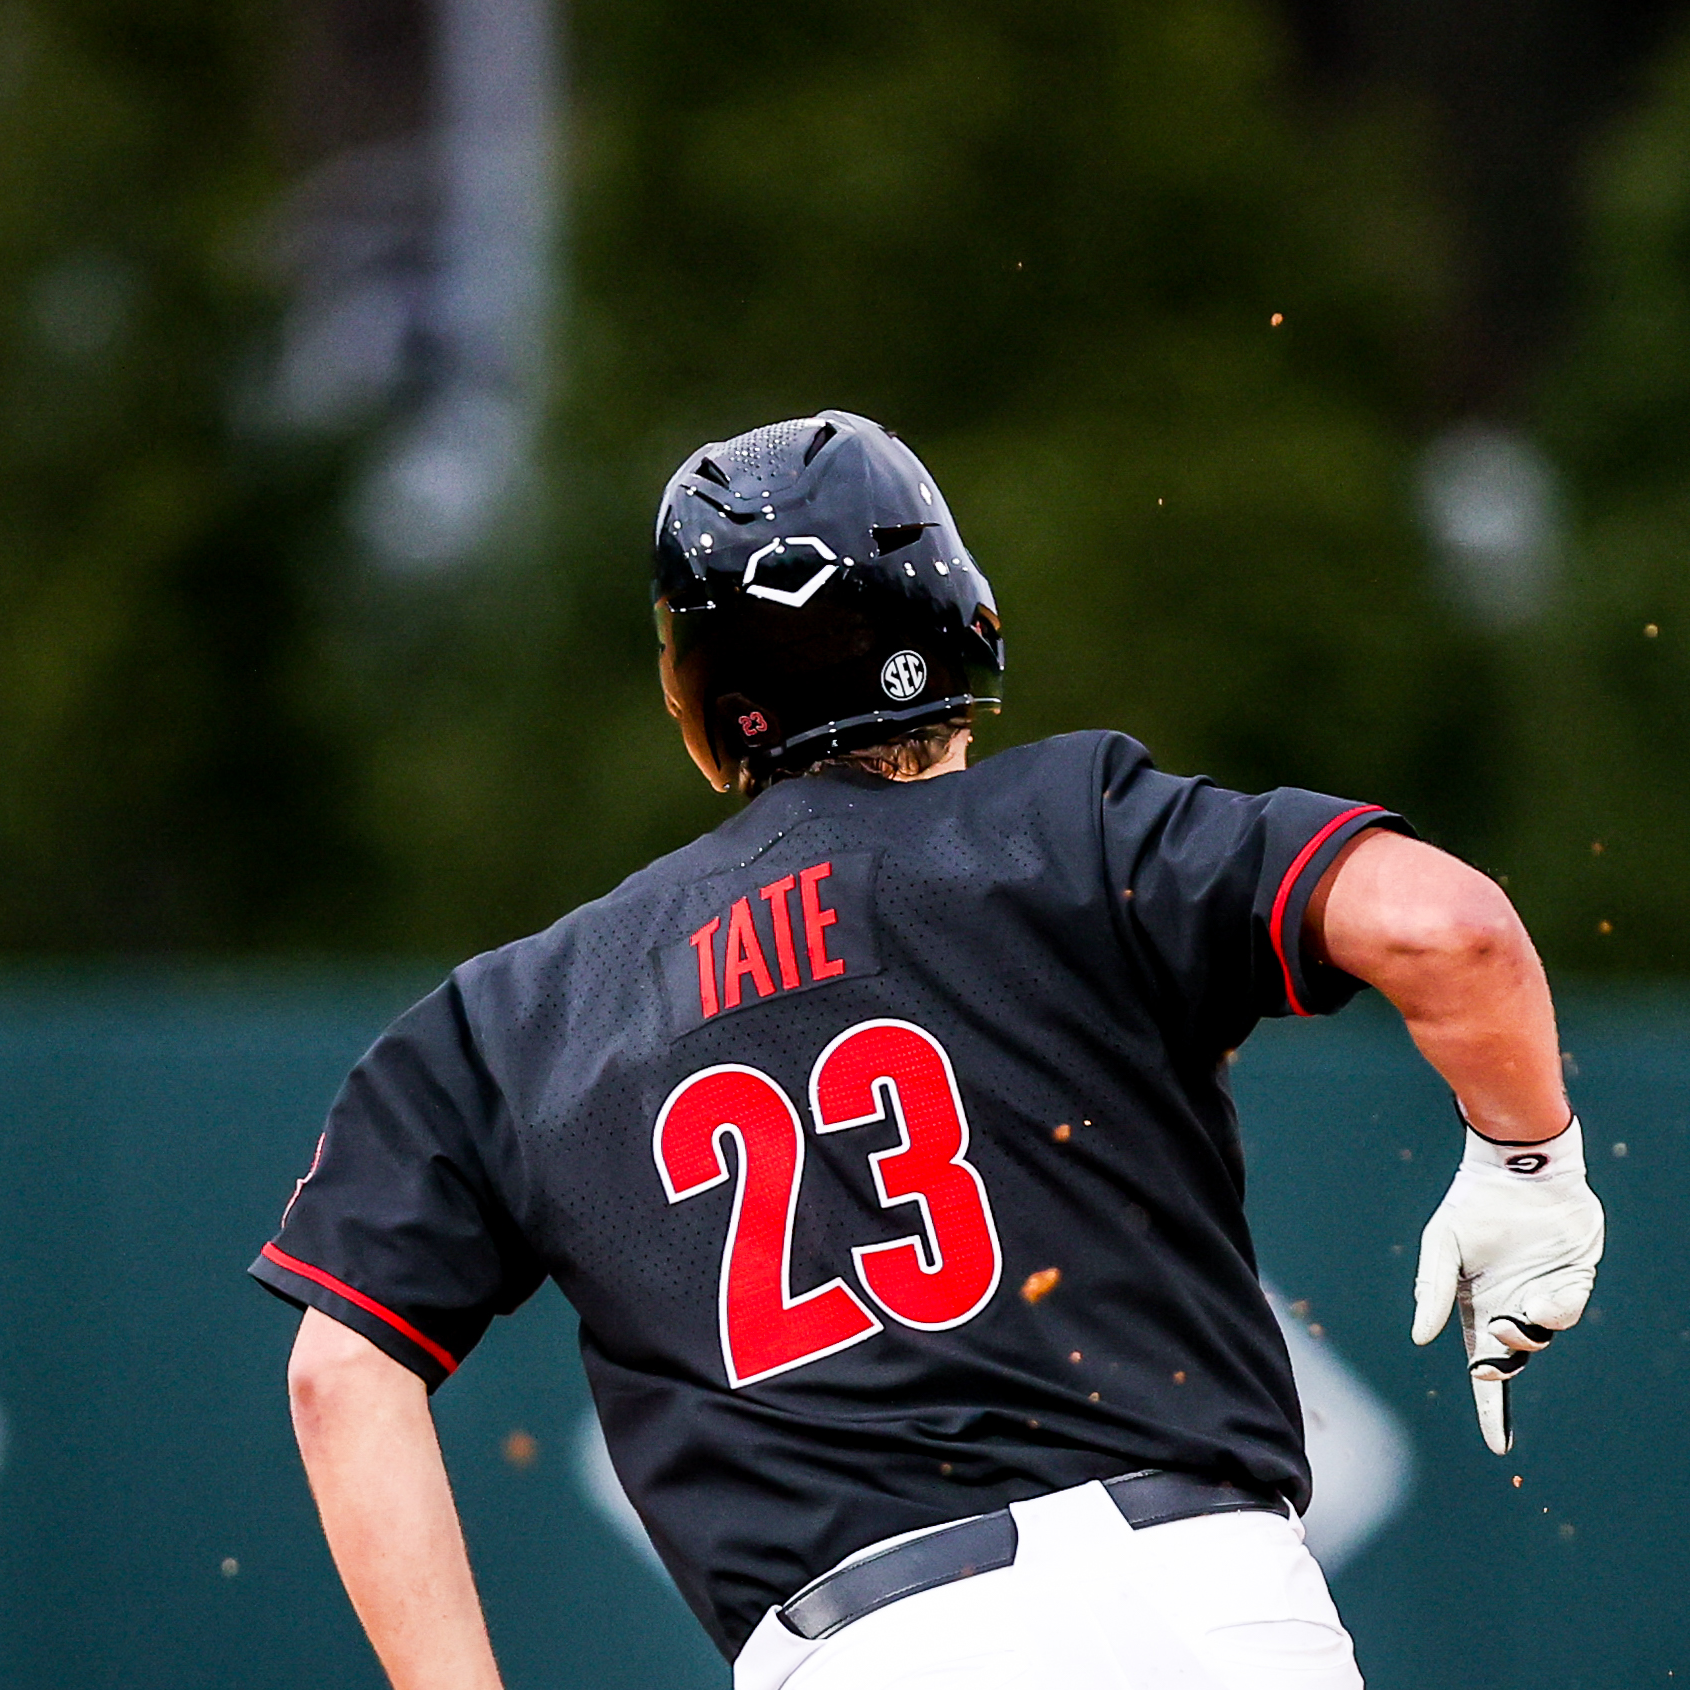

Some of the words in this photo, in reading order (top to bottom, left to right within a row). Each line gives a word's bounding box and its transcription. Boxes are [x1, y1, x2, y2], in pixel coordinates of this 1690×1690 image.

[884, 654, 924, 698] SEC
[738, 711, 768, 737] 23
[689, 861, 845, 1019] TATE
[1505, 1152, 1549, 1174] G
[653, 1018, 1002, 1390] 23
